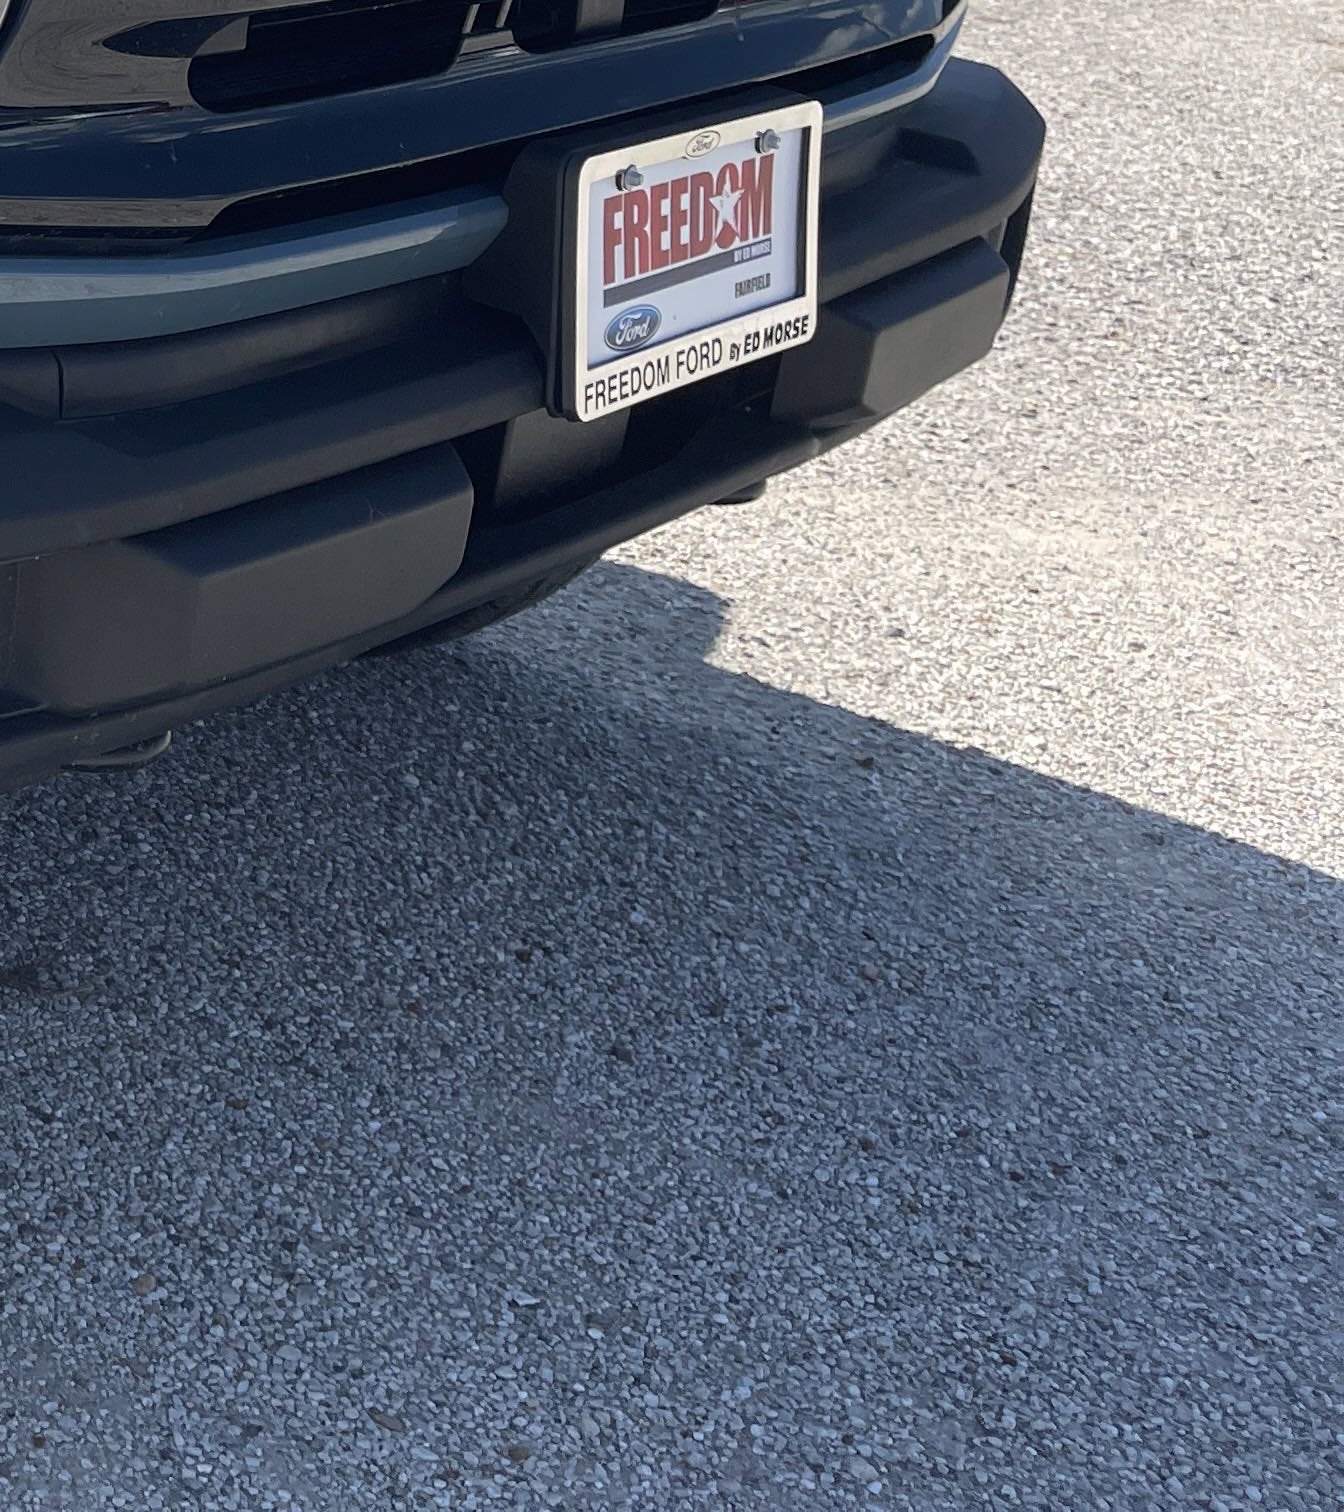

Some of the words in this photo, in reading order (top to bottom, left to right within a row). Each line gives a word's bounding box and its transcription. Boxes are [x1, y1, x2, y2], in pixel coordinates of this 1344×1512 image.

[602, 153, 775, 286] FREEDOM
[735, 273, 771, 298] FAIRFIELD
[615, 314, 651, 346] Ford
[584, 355, 671, 414] FREEDOM
[676, 338, 722, 380] FORD
[743, 333, 760, 355] ED
[762, 315, 810, 347] MORSE
